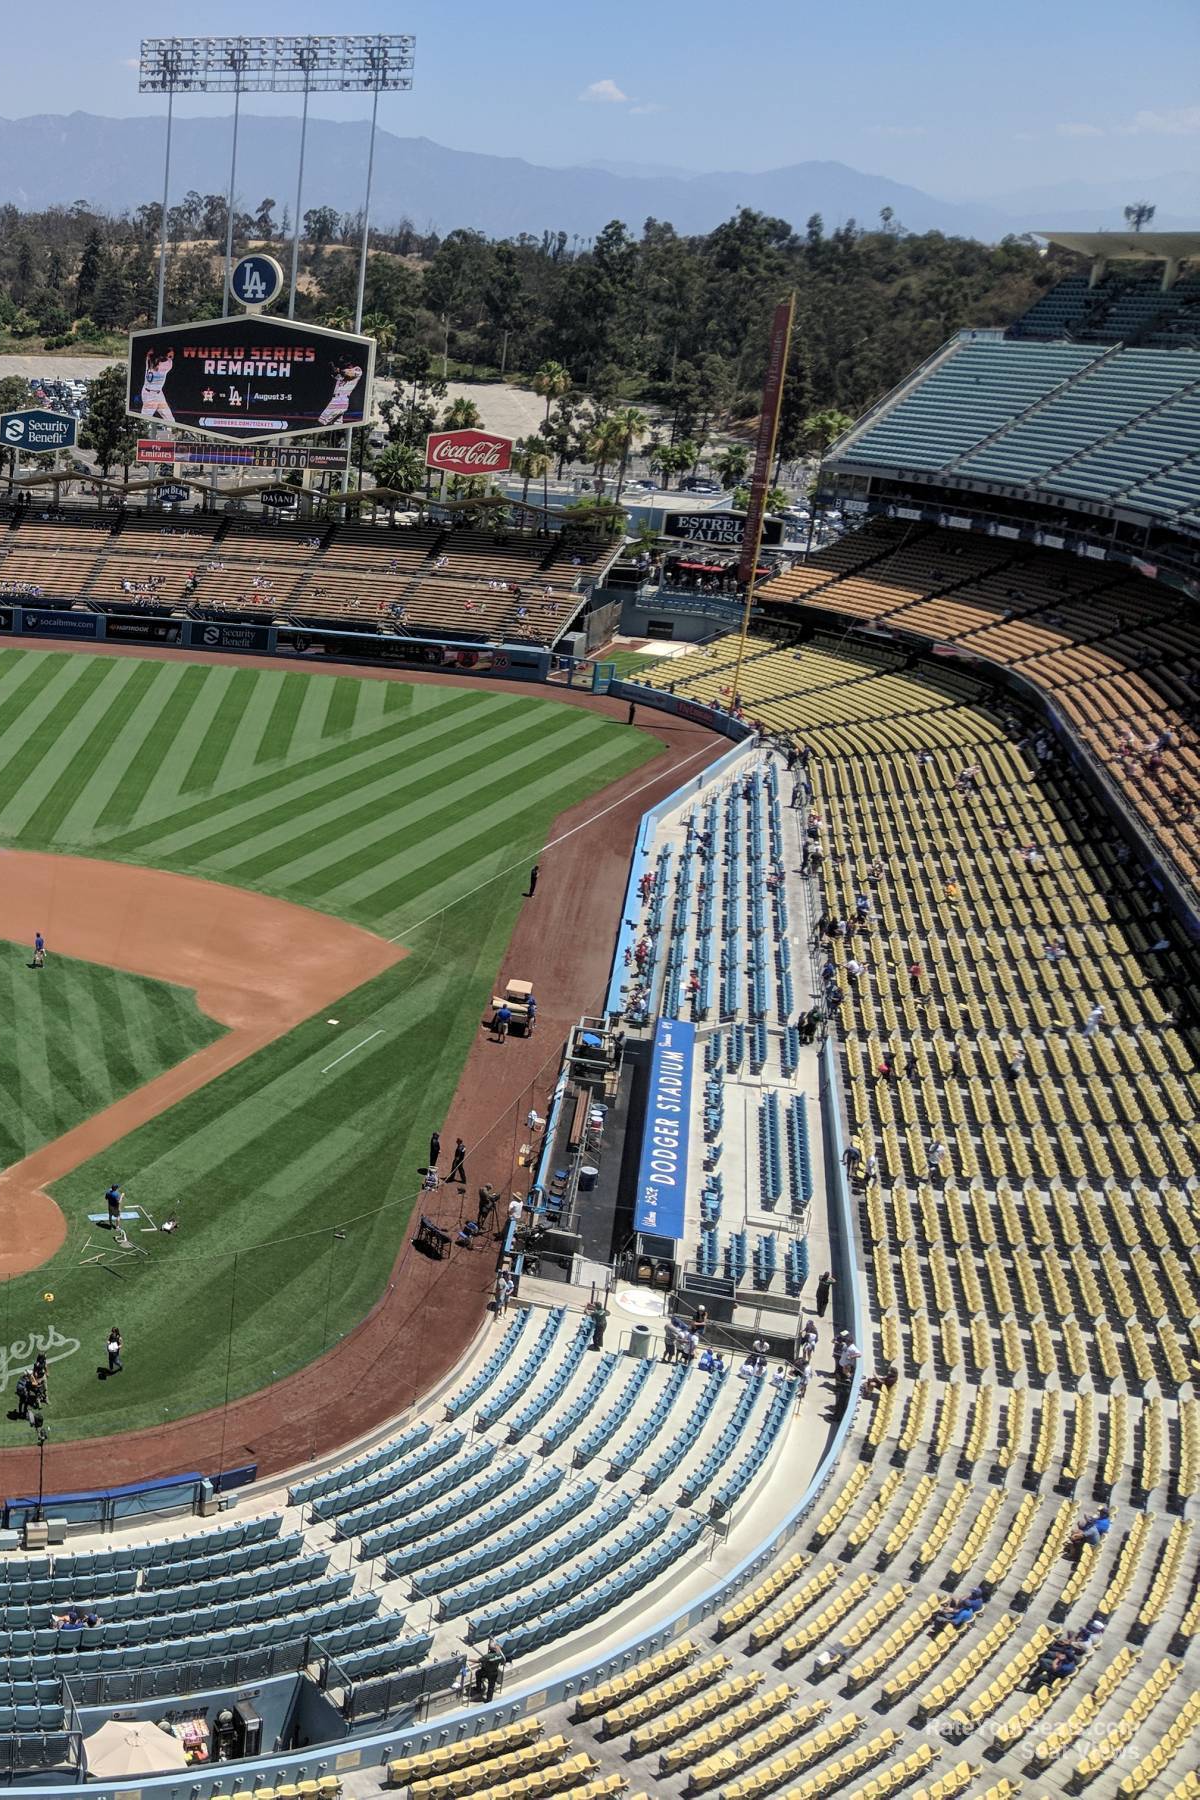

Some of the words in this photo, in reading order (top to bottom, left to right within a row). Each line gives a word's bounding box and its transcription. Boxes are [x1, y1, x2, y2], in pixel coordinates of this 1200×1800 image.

[242, 262, 266, 298] LA
[183, 346, 245, 359] WORLD
[250, 347, 316, 362] SERIES
[204, 360, 291, 377] REMATCH
[254, 392, 279, 402] August
[28, 420, 70, 434] Security
[28, 432, 64, 443] Benefit
[141, 449, 172, 460] Emirates
[263, 493, 295, 503] DASANI
[678, 516, 768, 535] ESTRELA
[685, 530, 745, 545] JALISC
[222, 627, 256, 639] Security
[222, 637, 250, 647] Benefit
[656, 1051, 685, 1113] STADIUM
[650, 1117, 680, 1187] DODGER
